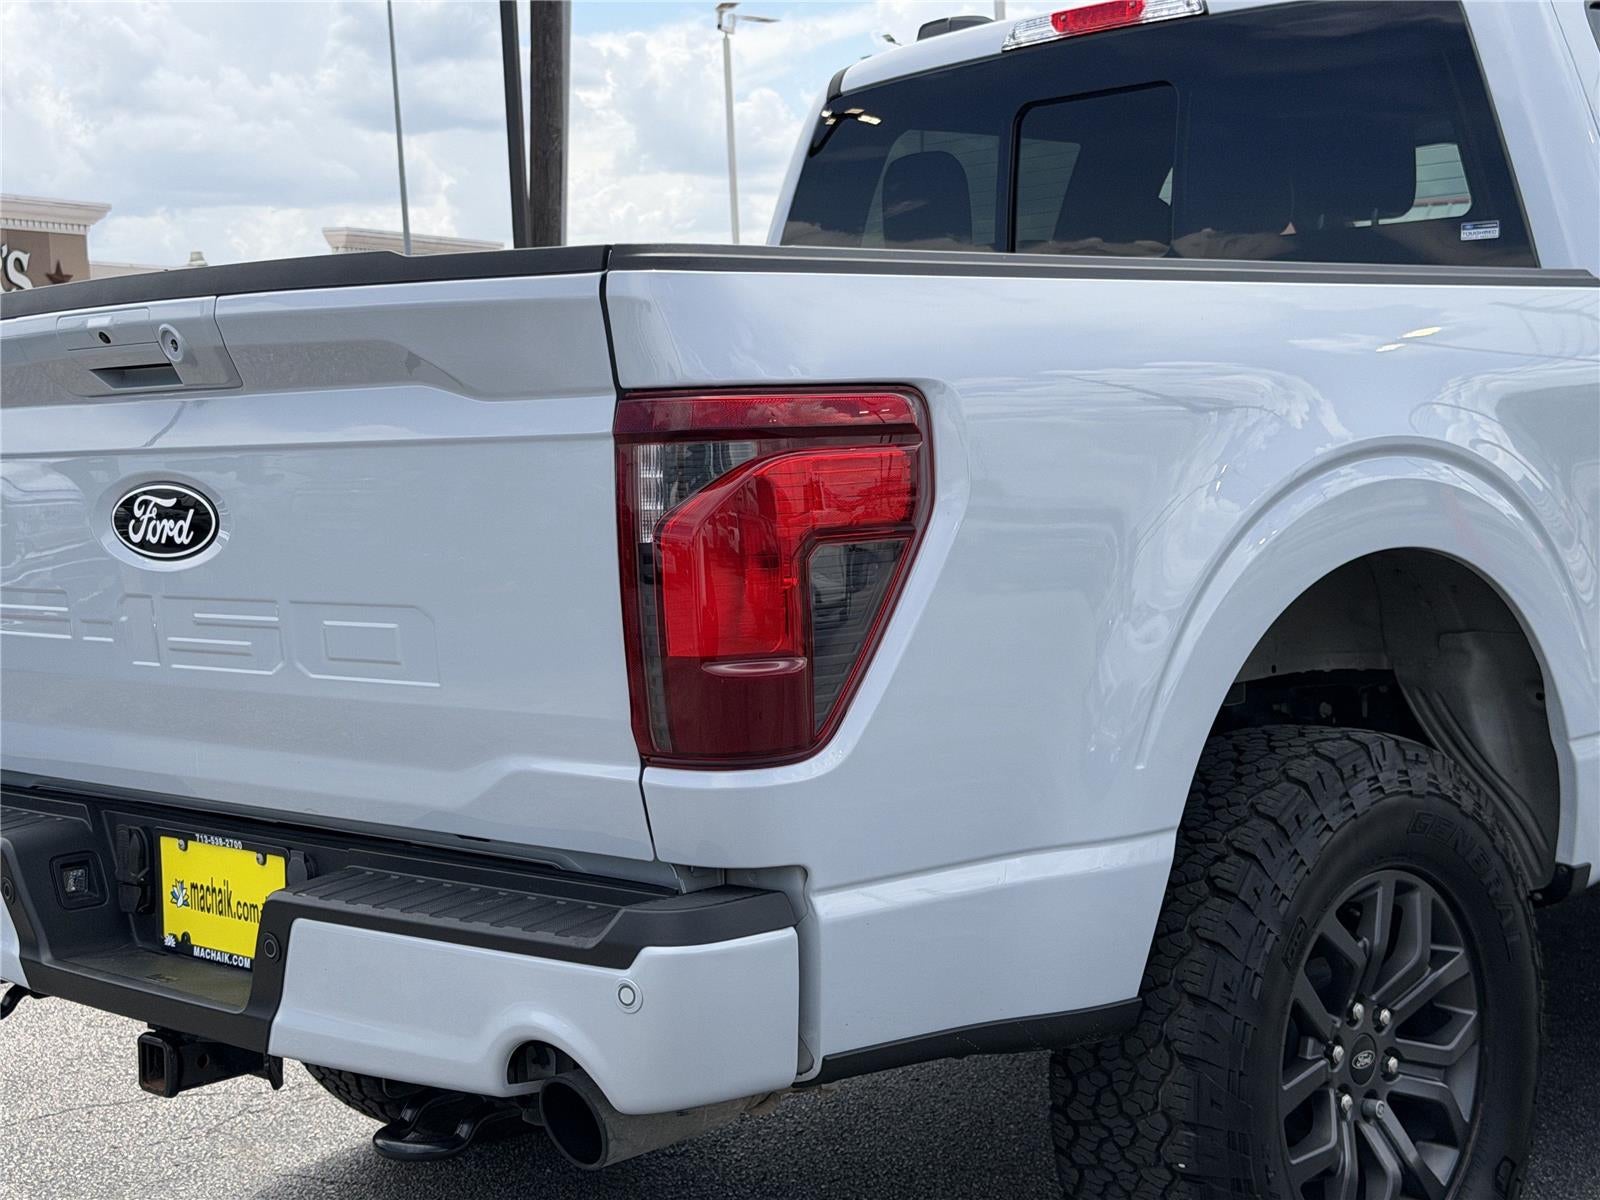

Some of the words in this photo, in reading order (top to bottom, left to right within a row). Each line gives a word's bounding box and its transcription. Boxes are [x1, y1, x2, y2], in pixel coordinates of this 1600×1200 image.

[128, 495, 196, 546] Ford
[190, 876, 260, 924] machaik.com
[193, 946, 251, 969] MACHAIK.COM
